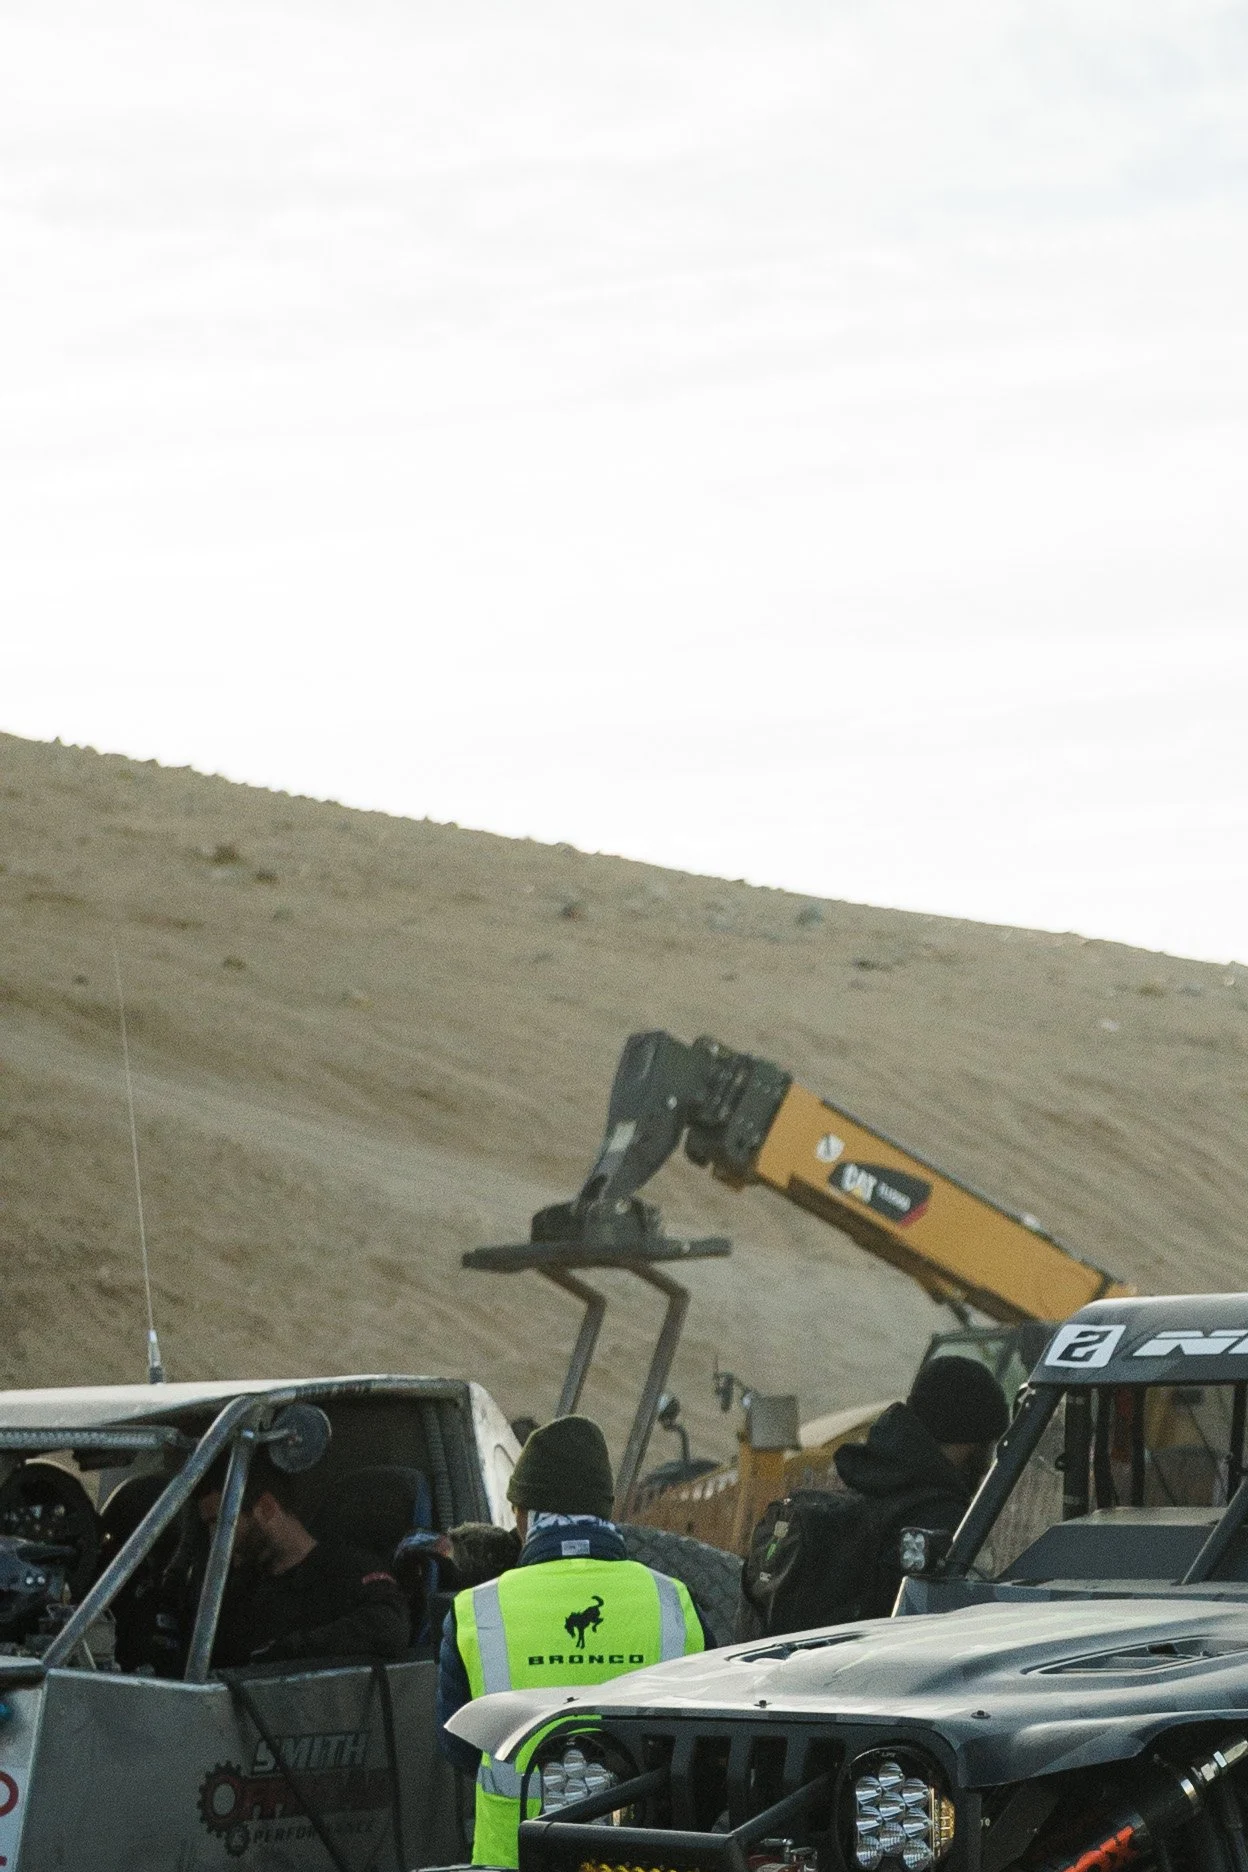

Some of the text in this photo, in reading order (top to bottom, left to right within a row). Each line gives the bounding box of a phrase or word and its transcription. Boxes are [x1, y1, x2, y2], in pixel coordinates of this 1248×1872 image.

[841, 1163, 877, 1204] CAT
[1057, 1330, 1112, 1362] 2
[528, 1654, 645, 1666] BRONCO
[252, 1731, 370, 1773] SMITH
